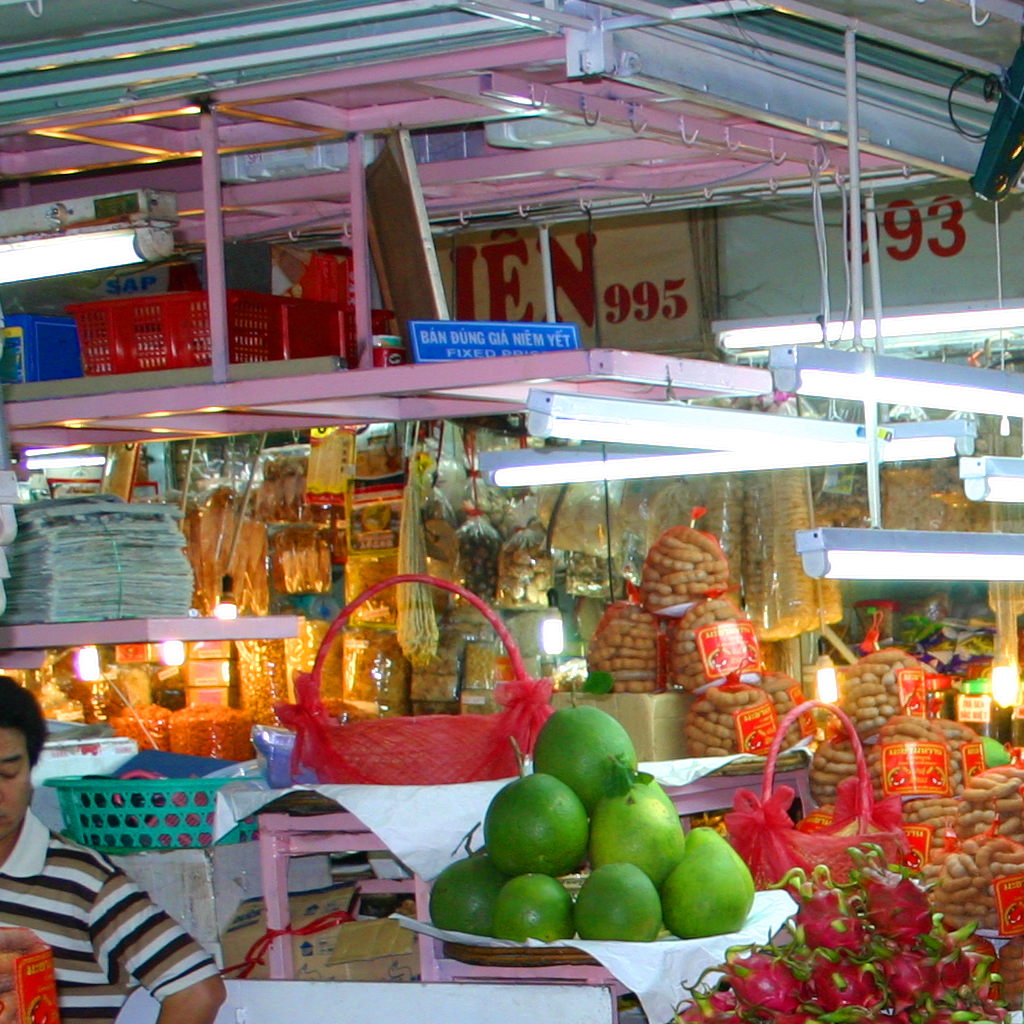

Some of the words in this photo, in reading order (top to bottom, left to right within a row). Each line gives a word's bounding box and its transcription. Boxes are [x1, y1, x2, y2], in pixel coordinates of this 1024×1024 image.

[603, 278, 688, 324] 995
[420, 327, 447, 344] BÁN
[450, 328, 485, 345] ĐÚNG
[488, 328, 510, 346] GIÁ
